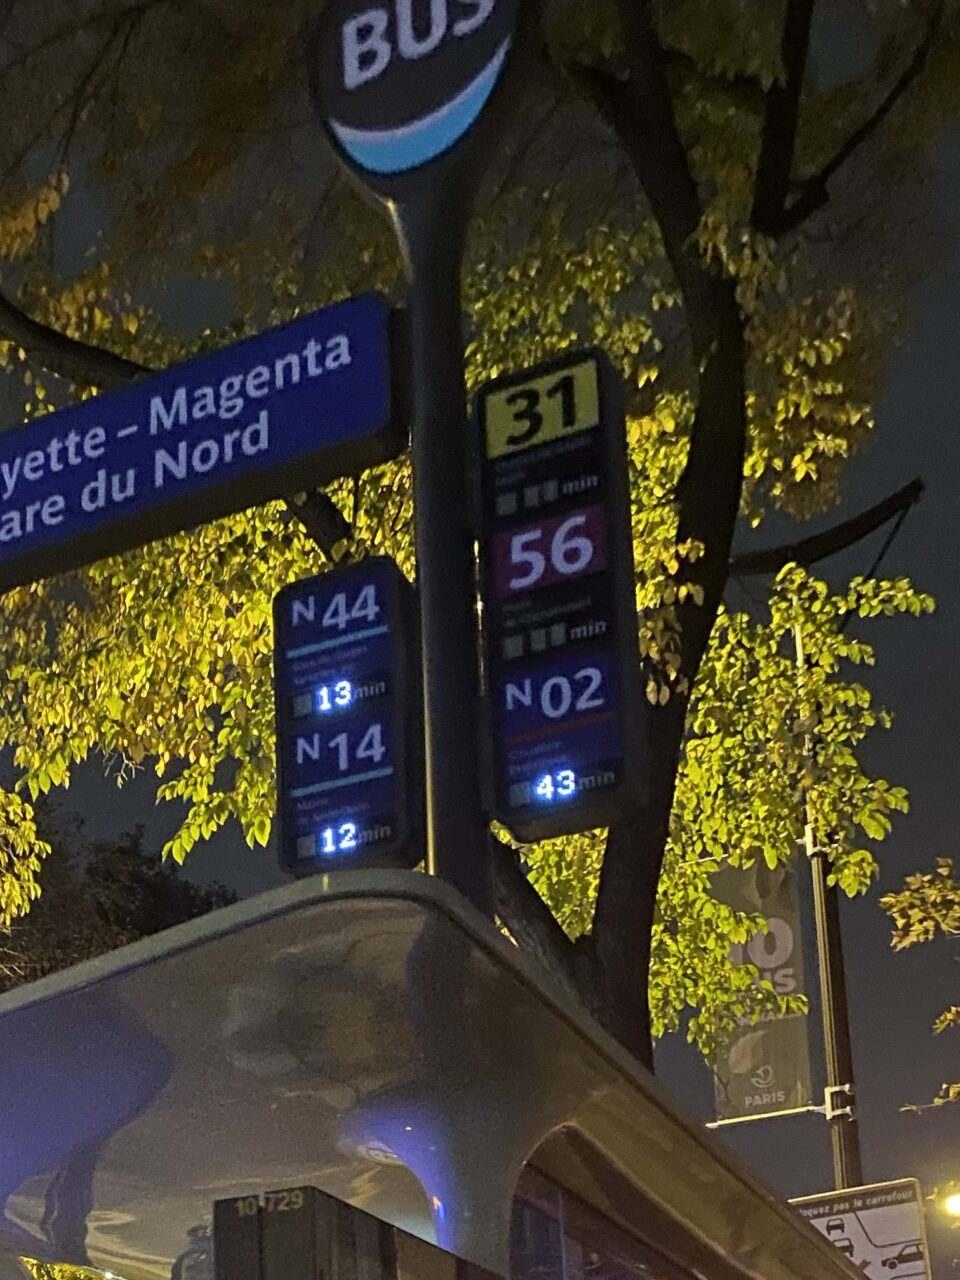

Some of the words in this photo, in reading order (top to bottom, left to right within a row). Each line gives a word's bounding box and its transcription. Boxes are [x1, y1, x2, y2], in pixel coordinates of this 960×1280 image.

[149, 333, 352, 436] Magenta
[506, 372, 577, 447] 31
[81, 466, 136, 513] du
[154, 410, 270, 487] Nord
[561, 473, 599, 496] min
[508, 513, 594, 590] 56
[570, 618, 607, 641] min
[318, 680, 352, 712] 13
[354, 679, 386, 699] min
[536, 769, 577, 801] 43
[578, 769, 616, 791] min
[321, 822, 357, 854] 12
[744, 1091, 786, 1108] PARIS
[833, 1202, 849, 1214] pas
[866, 1190, 913, 1206] carrefour
